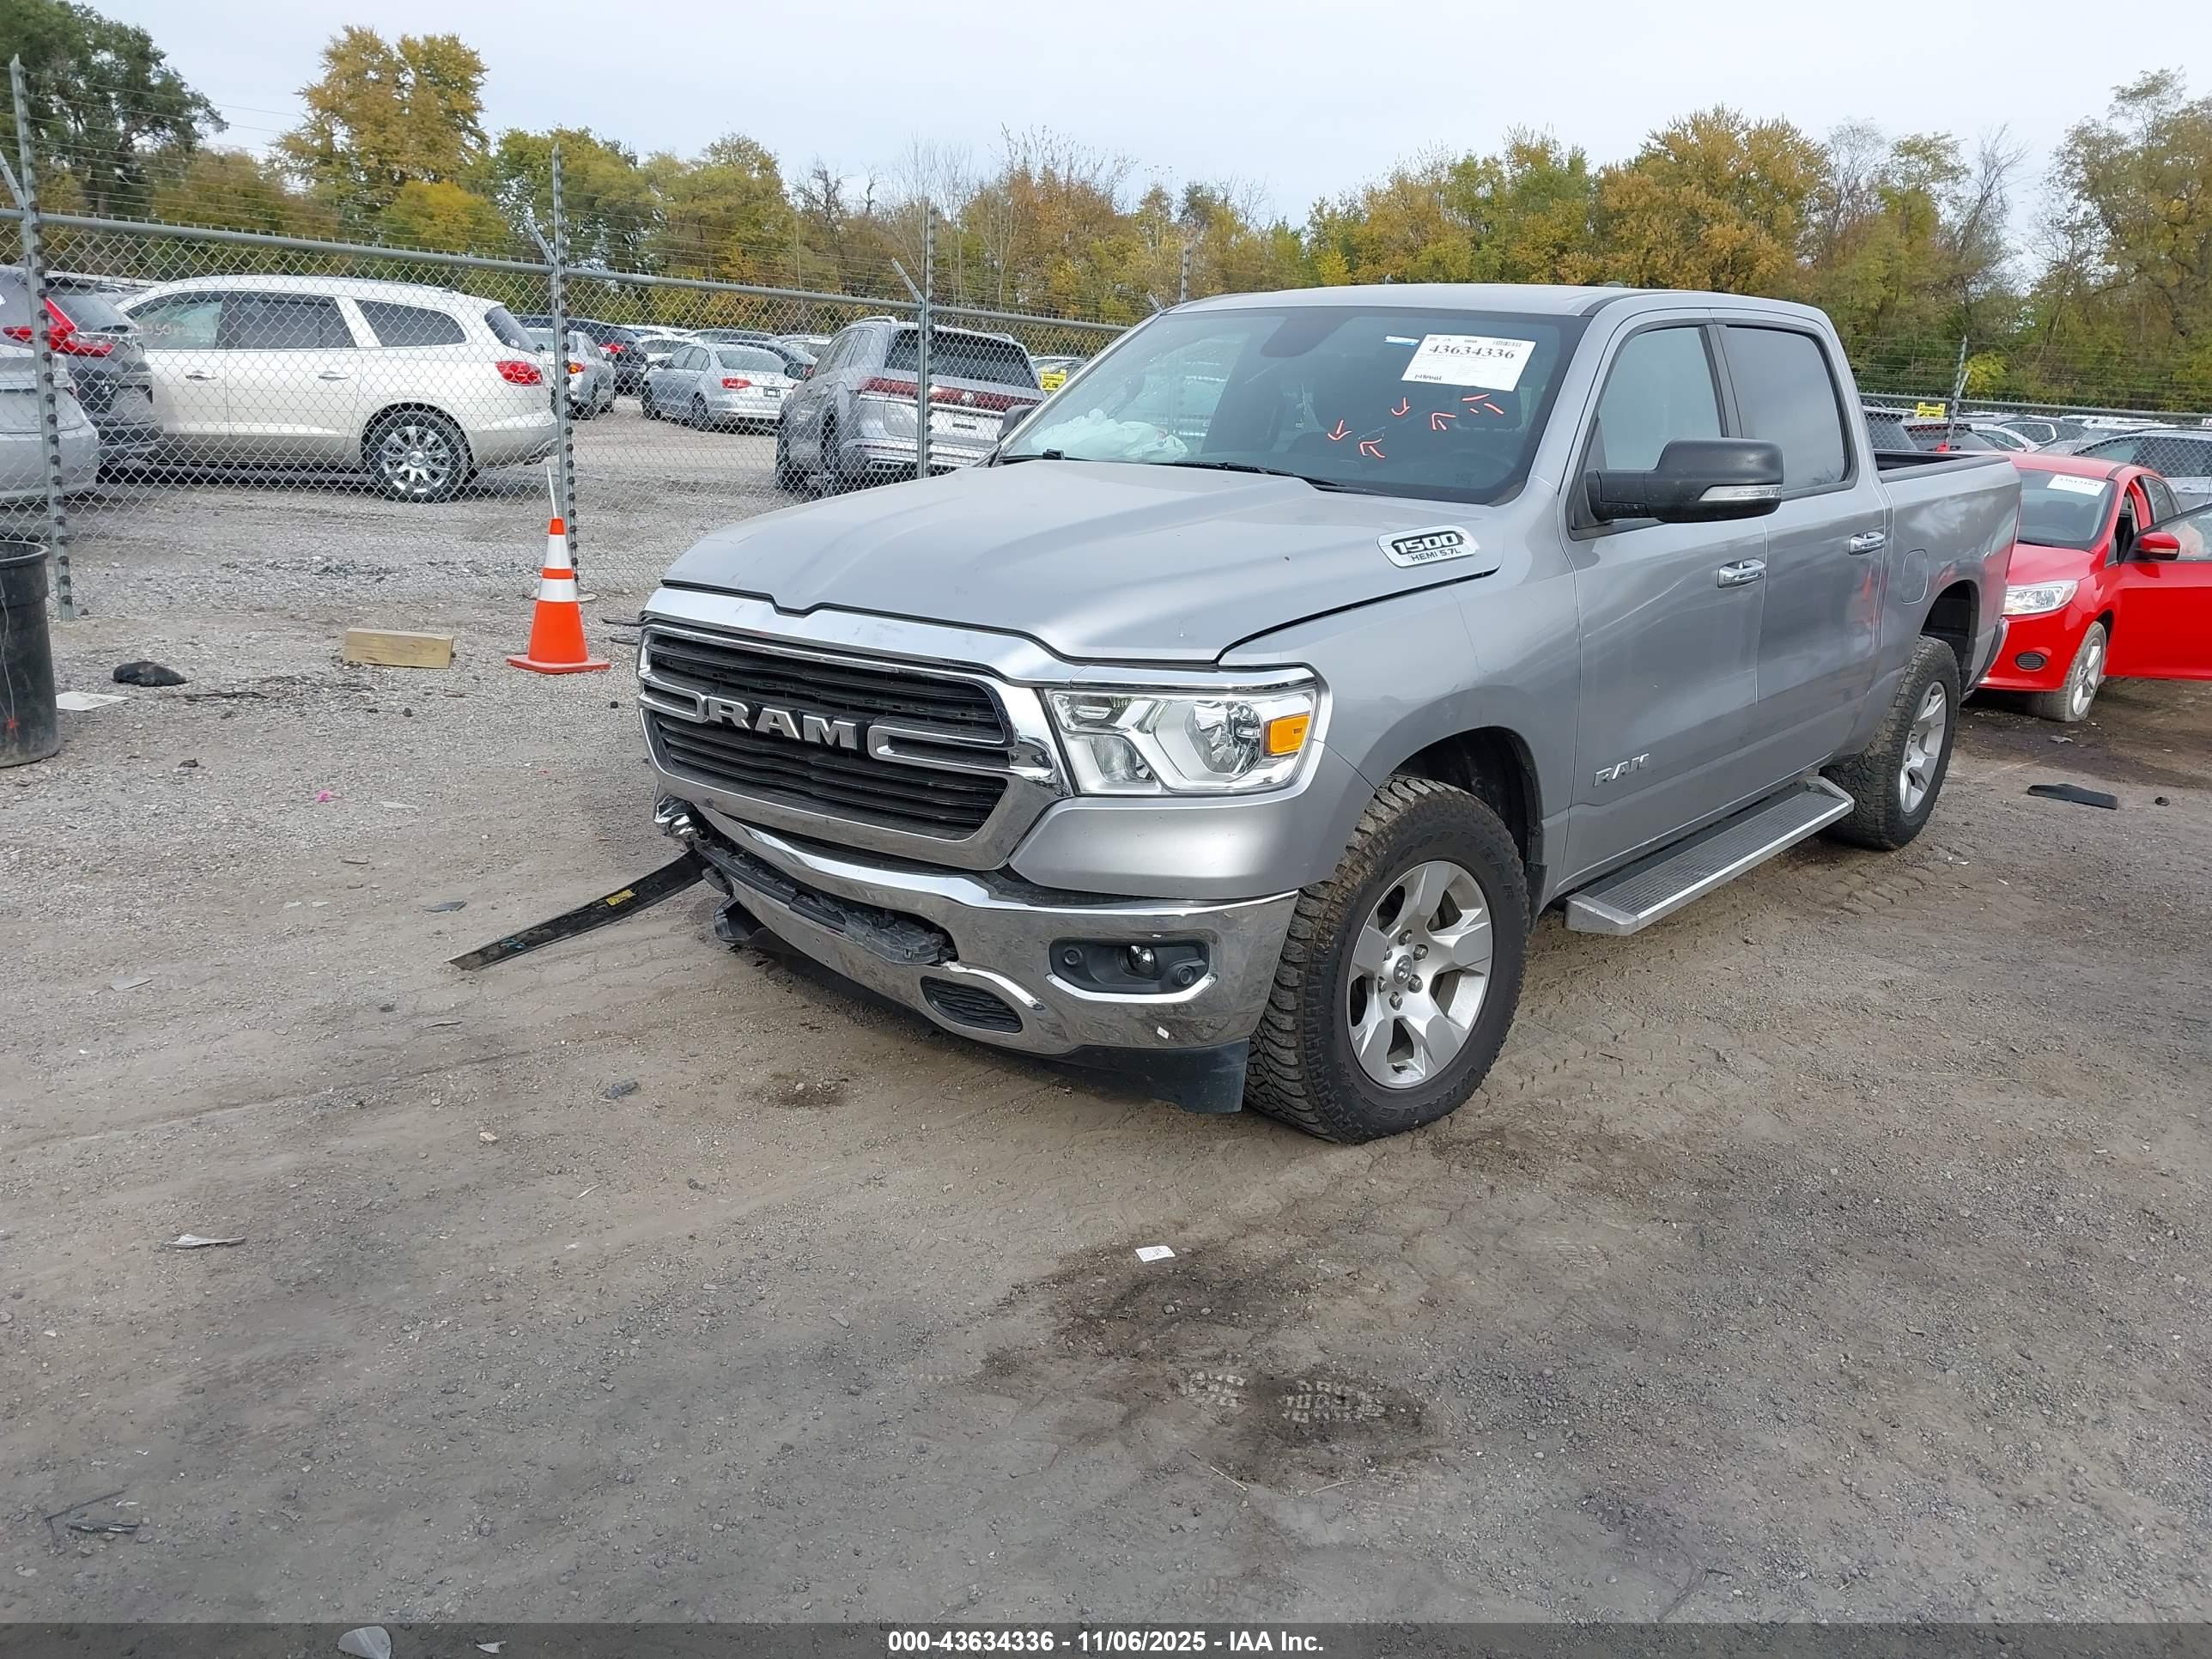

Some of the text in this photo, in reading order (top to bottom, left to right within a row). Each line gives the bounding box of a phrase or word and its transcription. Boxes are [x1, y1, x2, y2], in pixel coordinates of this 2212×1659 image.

[1429, 344, 1516, 359] 43634336
[1394, 533, 1459, 554] 1500
[1410, 547, 1462, 562] HEMI 5.7L
[708, 696, 858, 750] RAM
[1593, 752, 1650, 787] RAM
